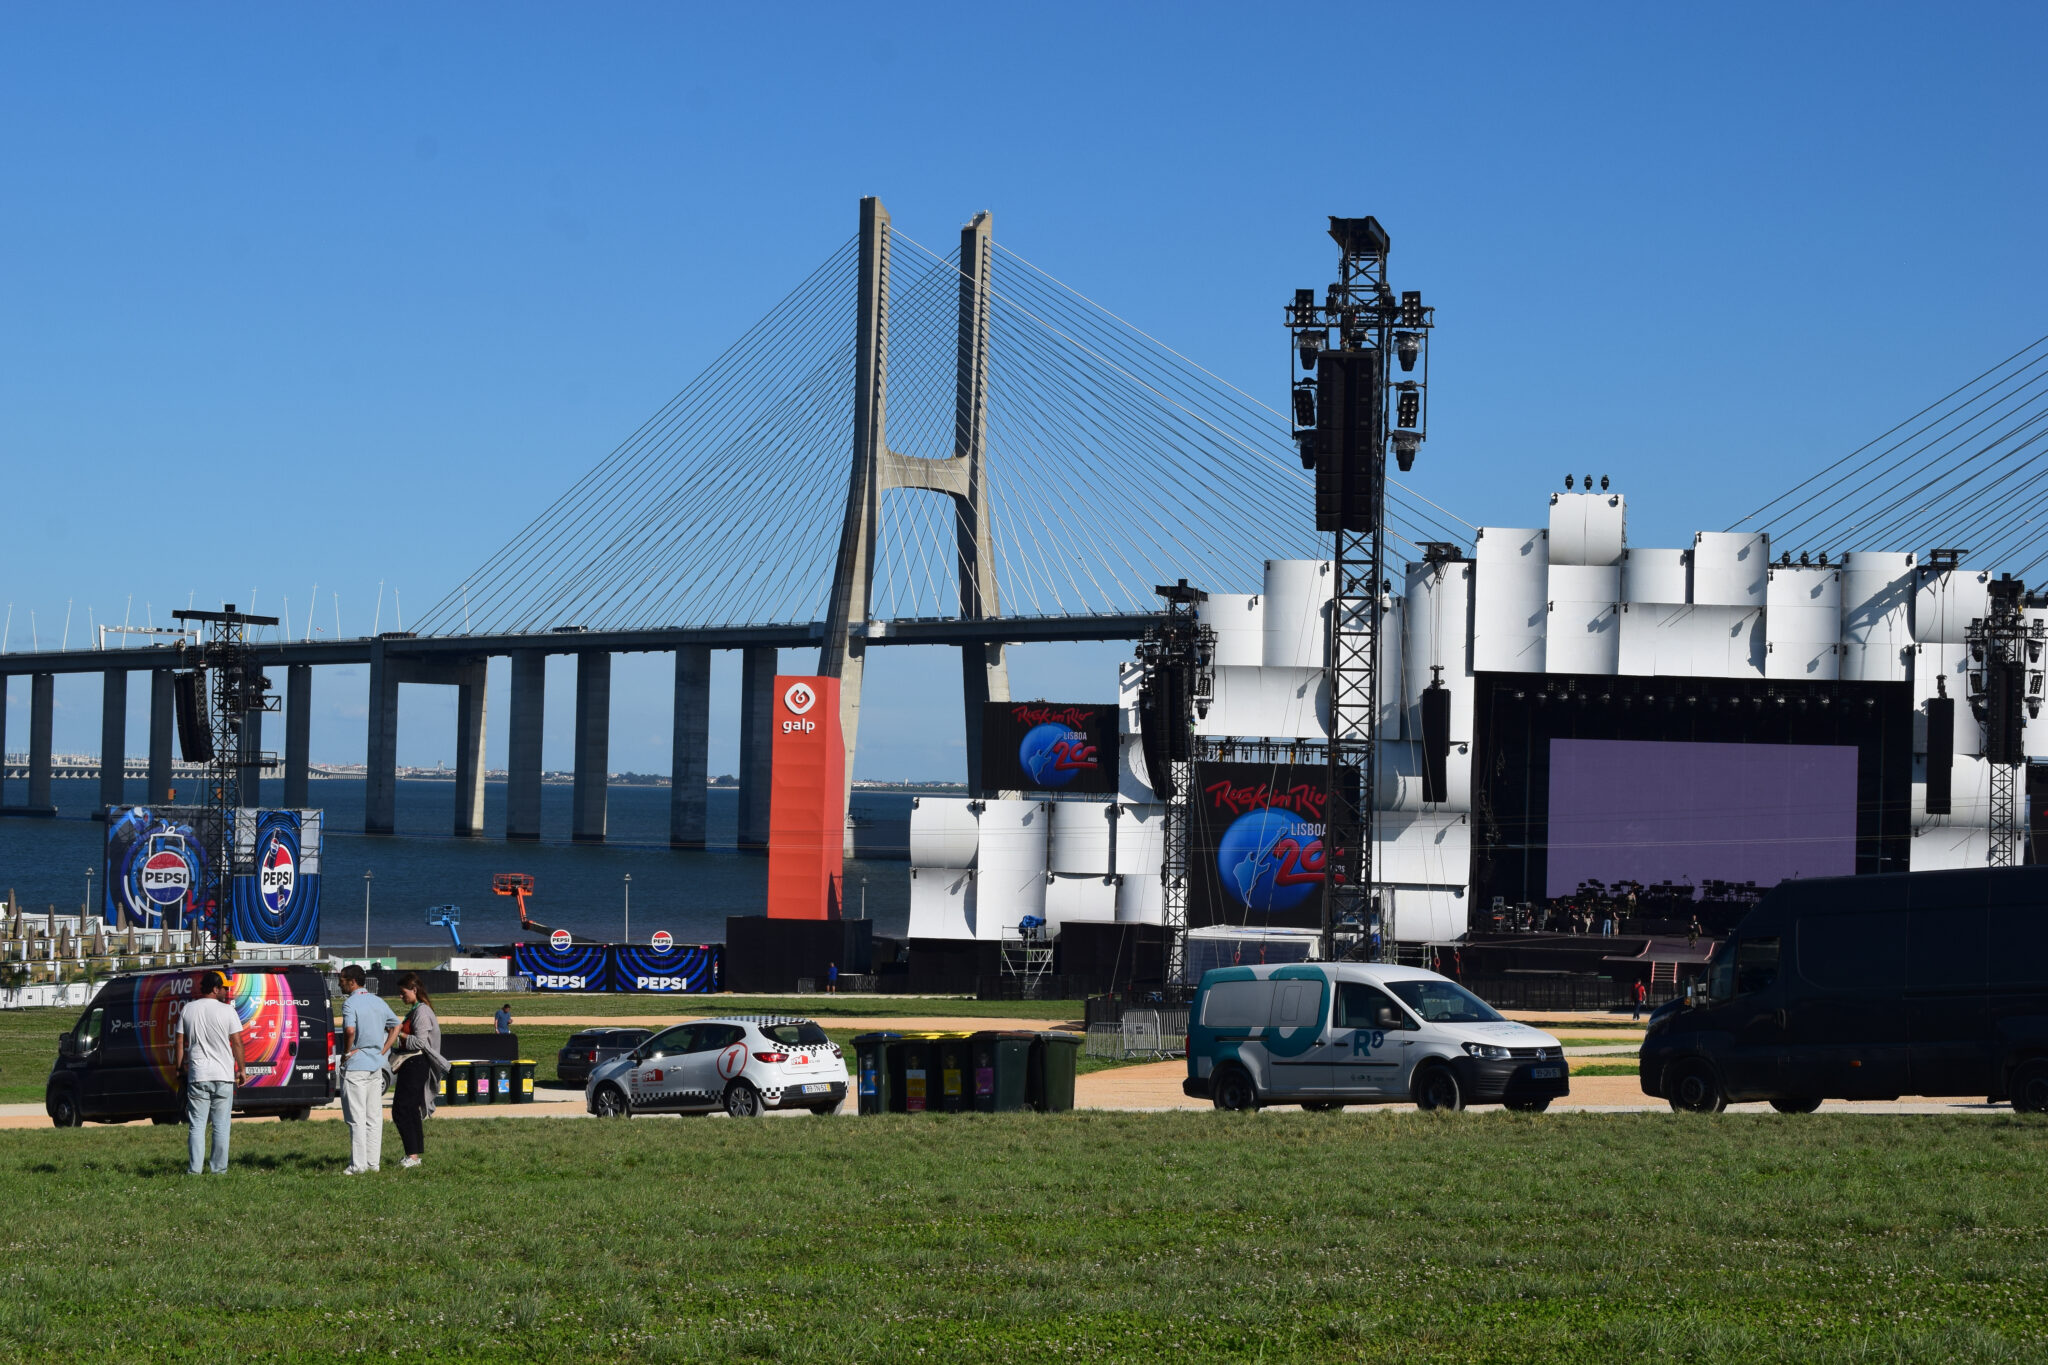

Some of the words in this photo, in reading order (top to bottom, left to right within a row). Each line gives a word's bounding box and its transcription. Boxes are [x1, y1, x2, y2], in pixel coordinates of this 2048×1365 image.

[1011, 705, 1051, 727] Rock
[1063, 707, 1094, 729] Rio
[782, 718, 815, 733] galp
[1063, 731, 1087, 740] LISBOA
[1206, 780, 1270, 815] Rock
[1270, 789, 1291, 808] in
[145, 872, 186, 884] PEPSI
[263, 871, 292, 885] PEPSI
[171, 977, 193, 995] we
[536, 975, 586, 989] PEPSI
[637, 977, 687, 990] PEPSI
[726, 1049, 740, 1073] 1
